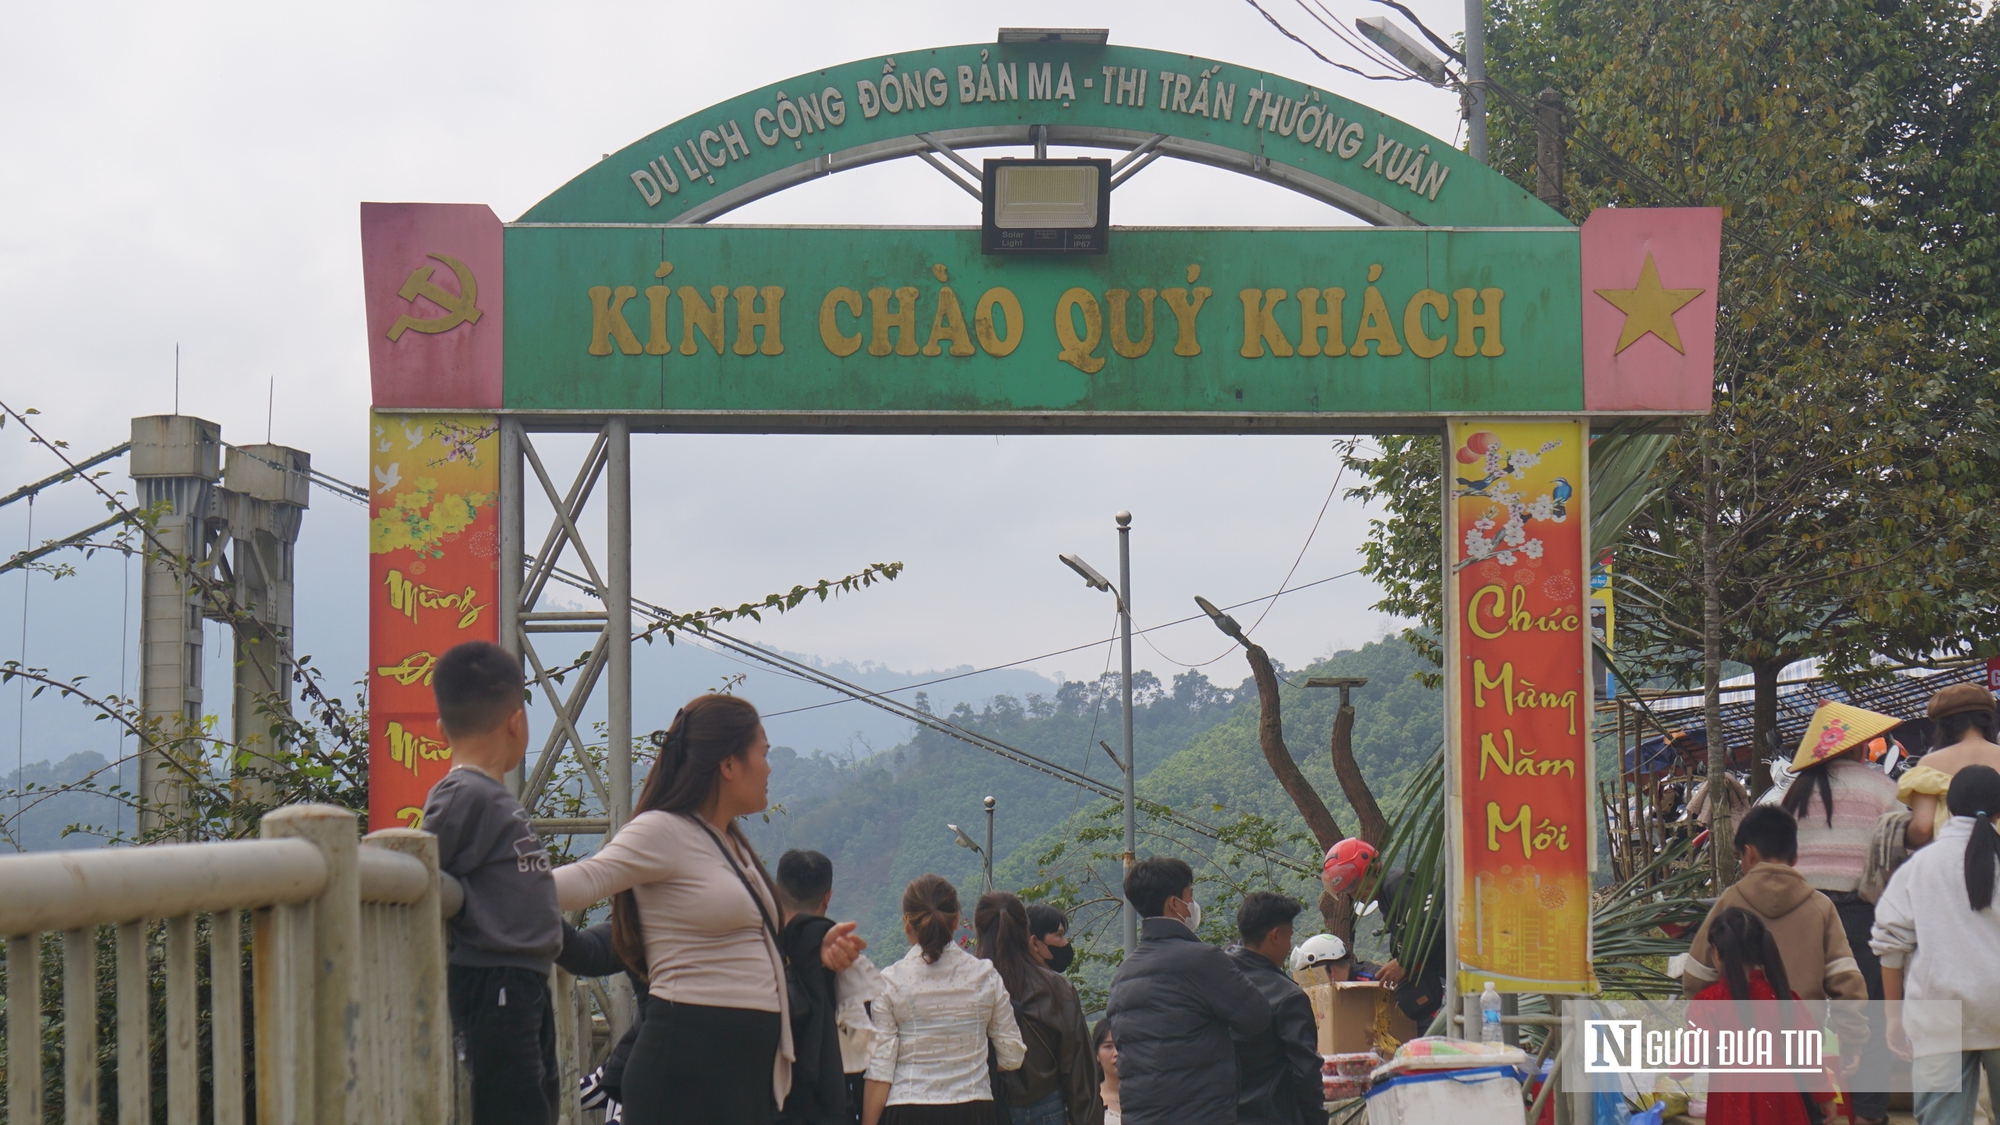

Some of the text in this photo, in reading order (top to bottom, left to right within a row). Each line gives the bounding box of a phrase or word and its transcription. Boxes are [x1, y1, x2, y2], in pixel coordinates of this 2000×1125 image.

[630, 155, 680, 207] DU
[673, 119, 750, 185] LỊCH
[754, 90, 846, 150] CỘNG
[857, 57, 948, 119] ĐỒNG
[957, 49, 1018, 104] BẢN
[1028, 62, 1076, 107] MẠ
[1159, 65, 1236, 121] TRẤN
[1242, 87, 1364, 159] THƯỜNG
[1362, 133, 1450, 201] XUÂN
[1002, 231, 1024, 239] Solar
[1002, 239, 1023, 248] Light
[588, 261, 1505, 374] KÍNH CHÀO QUÝ KHÁCH
[1468, 584, 1580, 639] Chúc
[1473, 659, 1578, 735] Mừng
[1479, 729, 1575, 782] Năm
[1486, 801, 1570, 859] Mới
